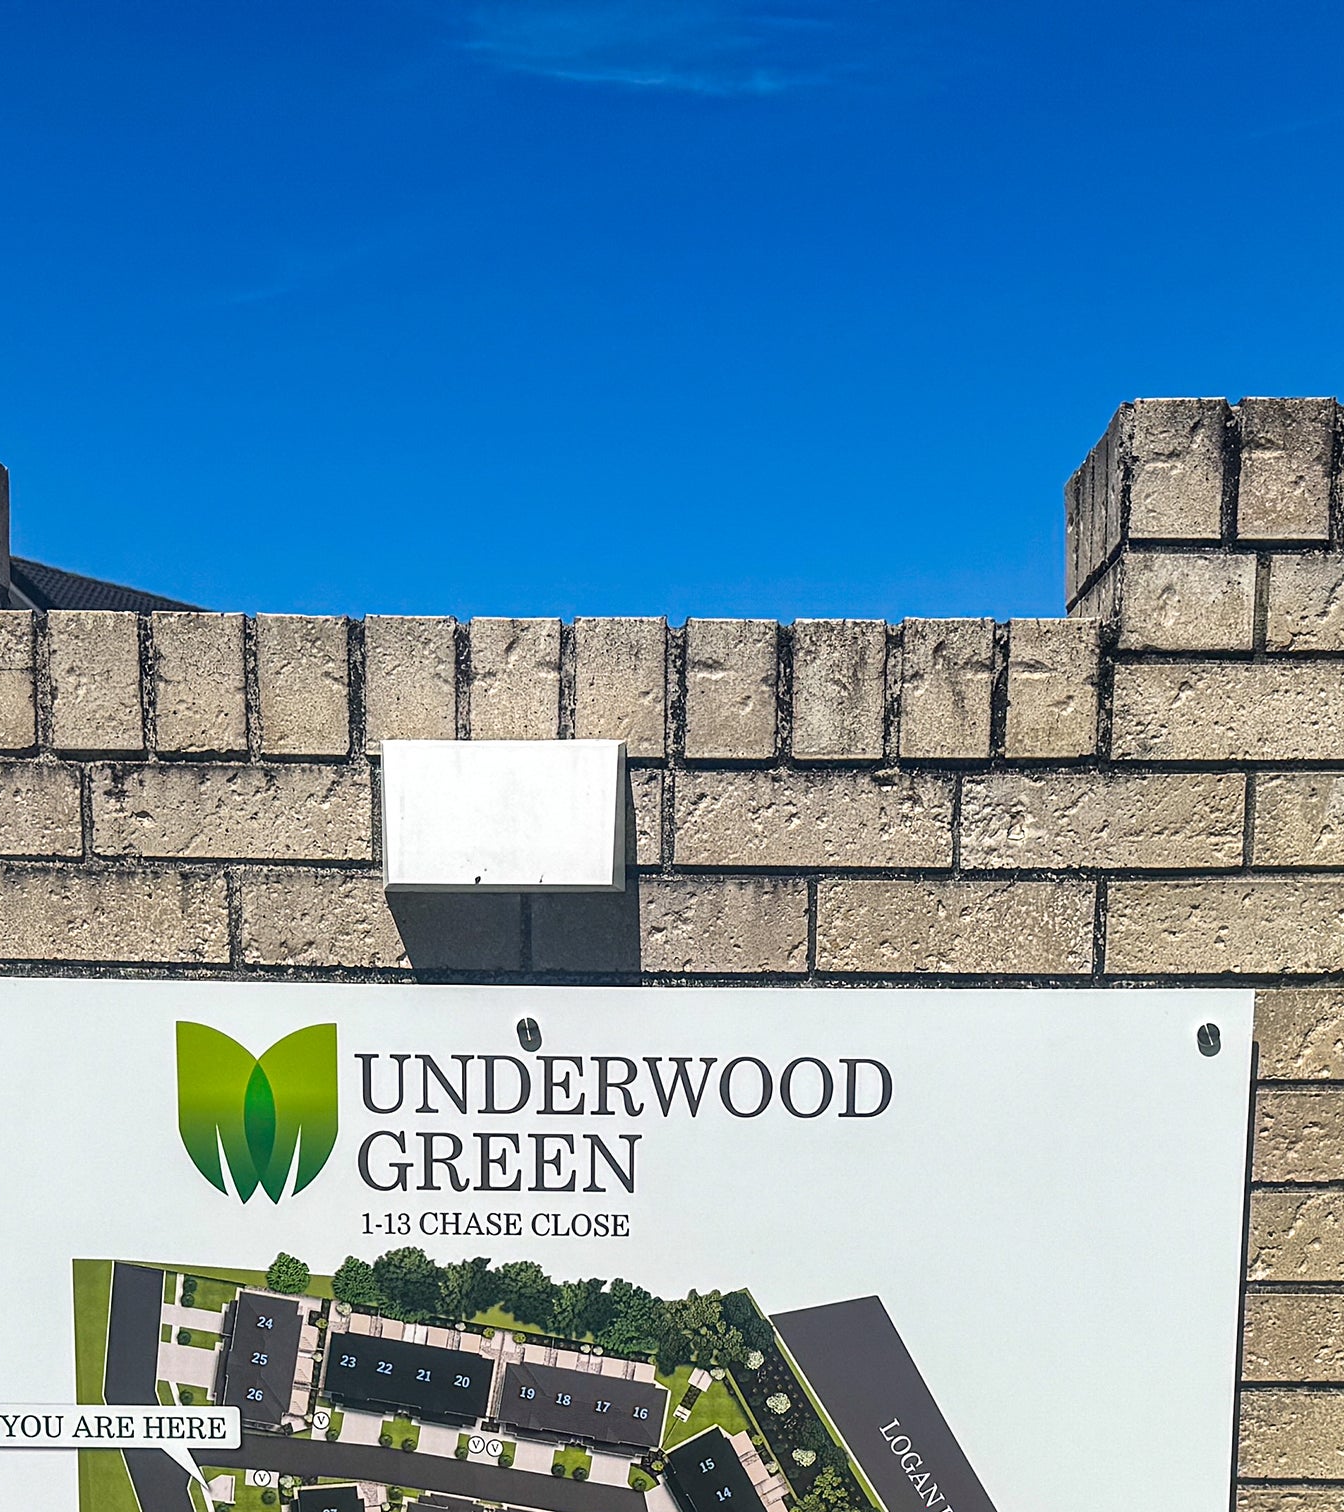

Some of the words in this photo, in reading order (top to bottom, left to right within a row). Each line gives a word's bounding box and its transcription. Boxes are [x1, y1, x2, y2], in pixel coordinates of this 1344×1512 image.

[354, 1053, 893, 1119] UNDERWOOD
[358, 1131, 642, 1193] GREEN
[363, 1213, 410, 1235] 1-13
[420, 1212, 522, 1235] CHASE
[532, 1213, 629, 1237] CLOSE
[256, 1316, 273, 1330] 24
[251, 1352, 268, 1365] 25
[339, 1354, 357, 1368] 23
[376, 1361, 393, 1375] 22
[415, 1369, 431, 1382] 21
[453, 1374, 470, 1388] 20
[246, 1388, 263, 1401] 26
[519, 1386, 535, 1400] 19
[555, 1393, 571, 1406] 18
[595, 1400, 611, 1413] 17
[633, 1406, 648, 1420] 16
[0, 1415, 64, 1438] YOU
[72, 1416, 134, 1438] ARE
[143, 1417, 226, 1439] HERE
[699, 1458, 715, 1473] 15
[879, 1418, 946, 1508] LOGAN
[716, 1486, 732, 1502] 14
